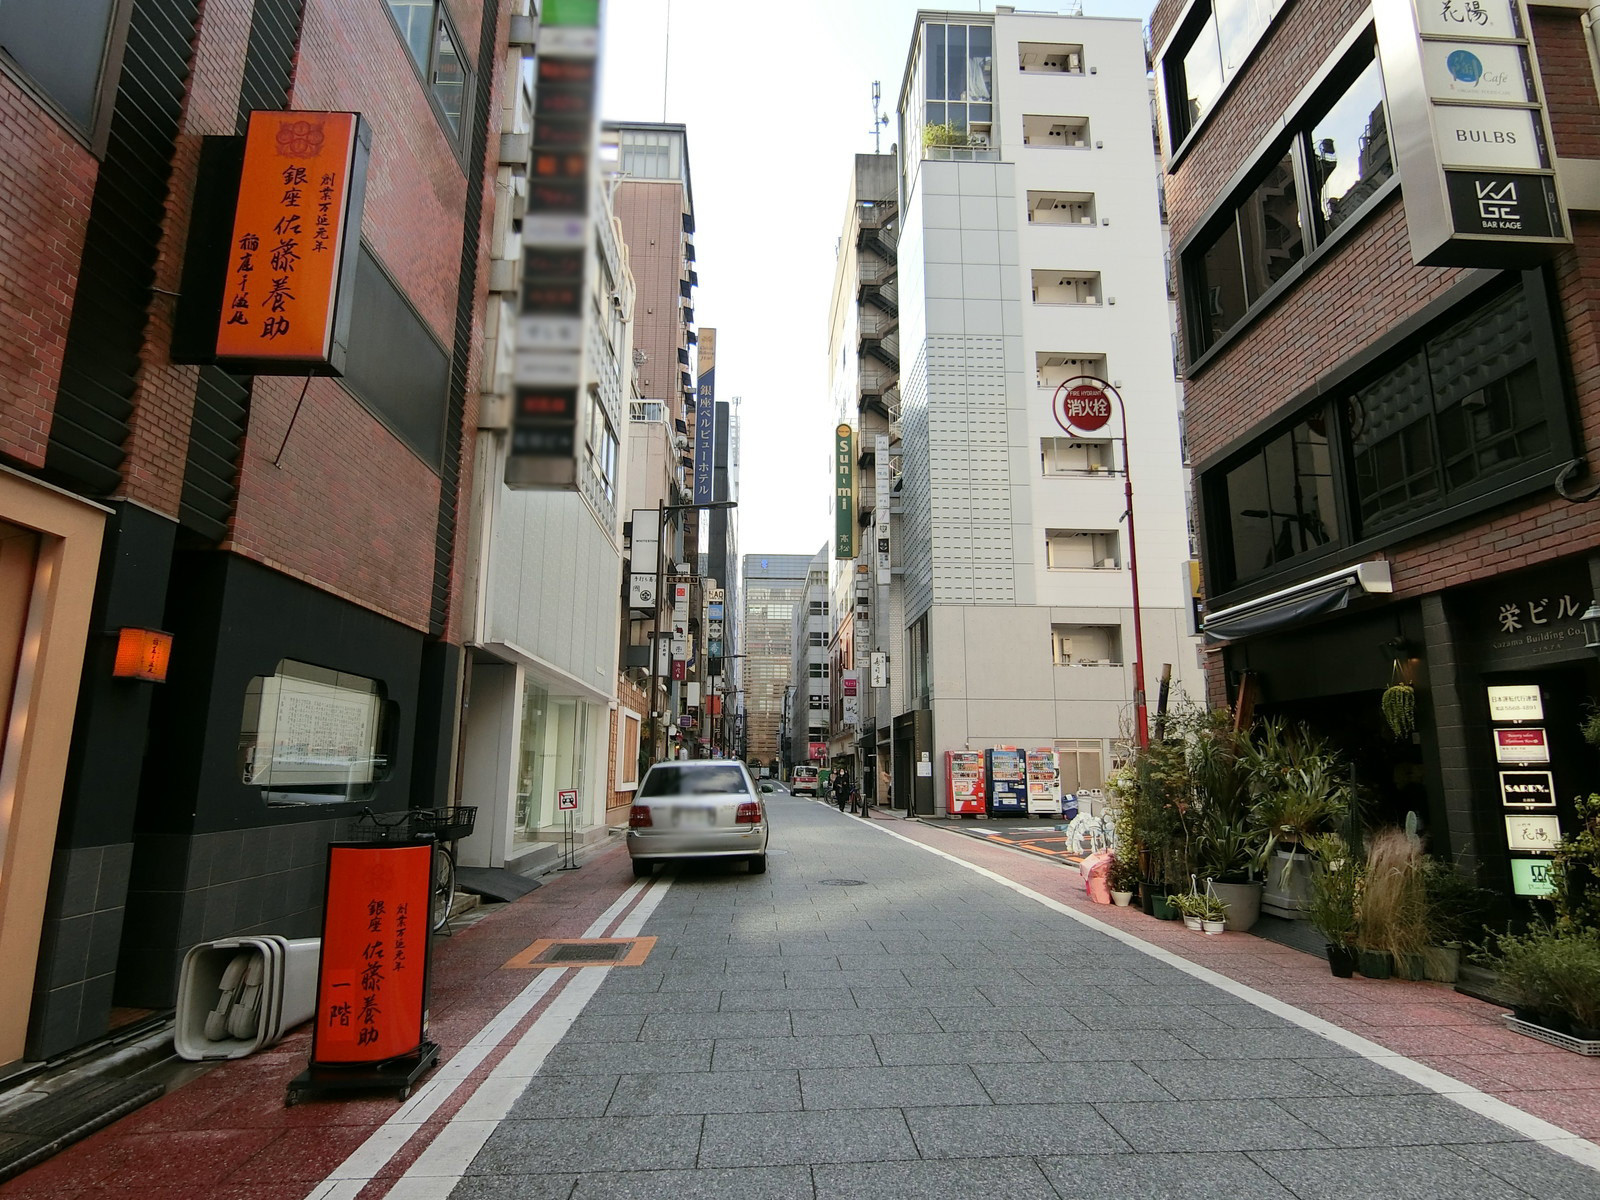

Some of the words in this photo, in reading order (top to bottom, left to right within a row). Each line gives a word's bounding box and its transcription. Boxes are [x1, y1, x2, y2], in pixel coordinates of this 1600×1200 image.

[1456, 129, 1517, 144] BULBS
[1482, 220, 1498, 228] BAR
[1500, 221, 1522, 230] KAGE
[1067, 398, 1108, 417] 消火栓
[698, 384, 712, 495] 銀座ベルビューホテル
[1499, 595, 1580, 633] 栄ビル
[1526, 630, 1565, 645] Building
[330, 981, 352, 1028] 一階
